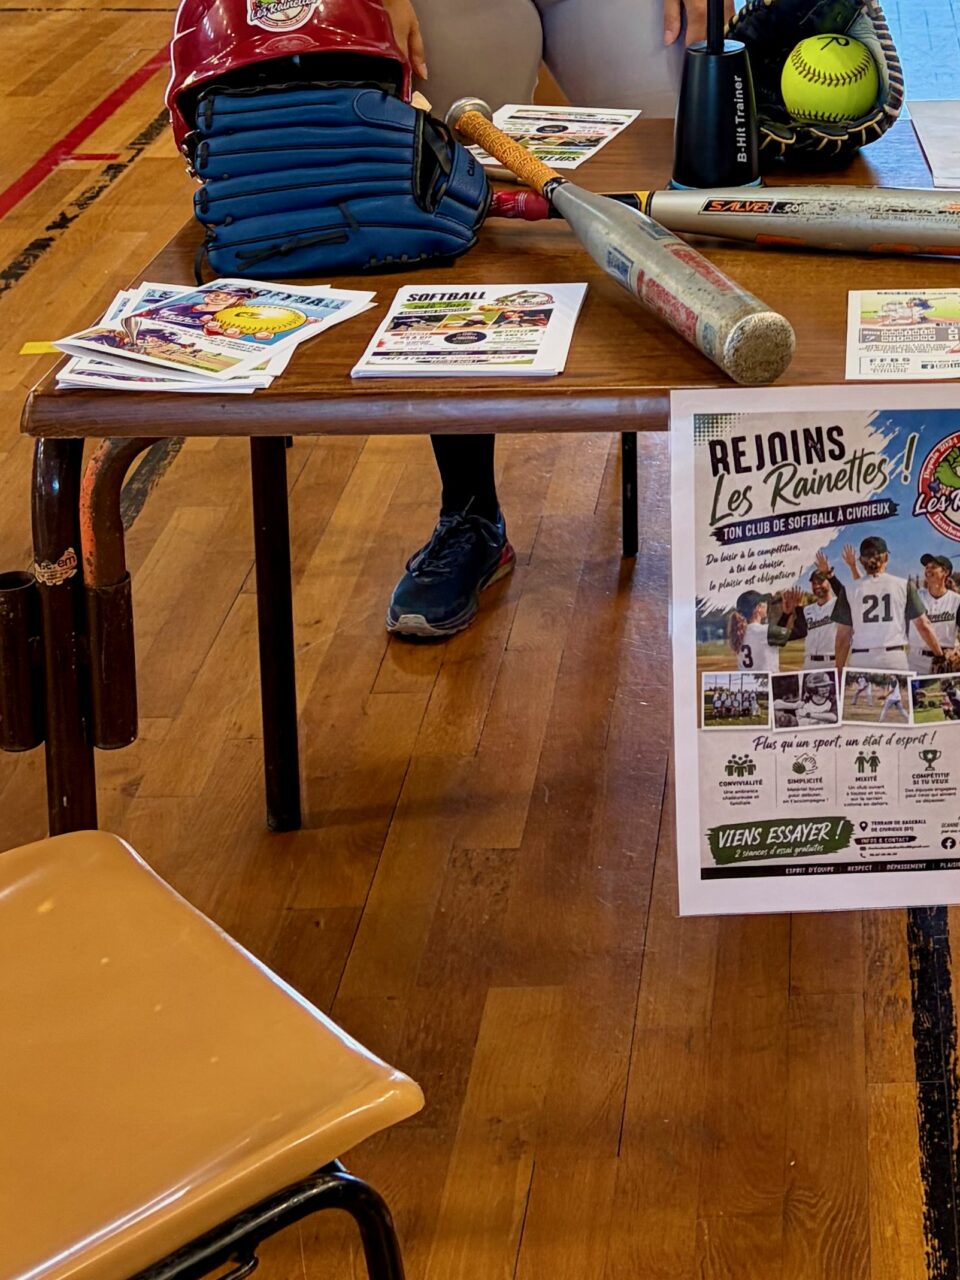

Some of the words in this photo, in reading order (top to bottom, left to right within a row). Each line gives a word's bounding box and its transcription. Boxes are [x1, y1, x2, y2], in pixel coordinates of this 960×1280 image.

[733, 74, 745, 125] Trainer
[736, 127, 748, 163] B-Hit
[406, 291, 486, 302] SOFTBALL
[709, 425, 846, 477] REJOINS
[709, 473, 753, 527] Les
[763, 448, 890, 514] Rainettes
[901, 433, 917, 483] !
[912, 493, 951, 517] Les
[723, 527, 743, 541] TON
[745, 524, 770, 538] CLUB
[773, 521, 786, 532] DE
[788, 514, 835, 531] SOFTBALL
[837, 510, 844, 522] À
[846, 502, 890, 521] CIVRIEUX
[706, 554, 718, 566] Du
[720, 552, 738, 562] loisir
[740, 551, 746, 559] à
[748, 548, 755, 558] la
[729, 566, 734, 574] à
[736, 566, 746, 574] toi
[748, 562, 757, 571] de
[709, 580, 716, 591] le
[718, 578, 743, 592] plaisir
[745, 575, 756, 586] est
[757, 571, 796, 586] obligatoire
[862, 593, 893, 624] 21
[741, 645, 754, 669] 3
[752, 735, 777, 752] Plus
[780, 735, 810, 753] qu'un
[812, 735, 842, 752] sport,
[845, 738, 860, 747] un
[862, 733, 883, 747] état
[885, 732, 929, 750] d'esprit
[929, 730, 937, 745] !
[718, 779, 763, 787] CONVIVIALITÉ
[787, 777, 823, 785] SIMPLICITÉ
[855, 775, 878, 783] MIXITÉ
[912, 771, 950, 779] COMPÉTITIF
[719, 827, 762, 848] VIENS
[766, 822, 832, 844] ESSAYER
[835, 820, 845, 840] !
[734, 849, 741, 858] 2
[742, 848, 768, 858] séances
[769, 845, 793, 856] d'essai
[794, 843, 824, 856] gratuites
[785, 867, 806, 875] ESPRIT
[808, 865, 834, 874] D'ÉQUIPE
[847, 864, 873, 872] RESPECT
[886, 862, 927, 871] DÉPASSEMENT
